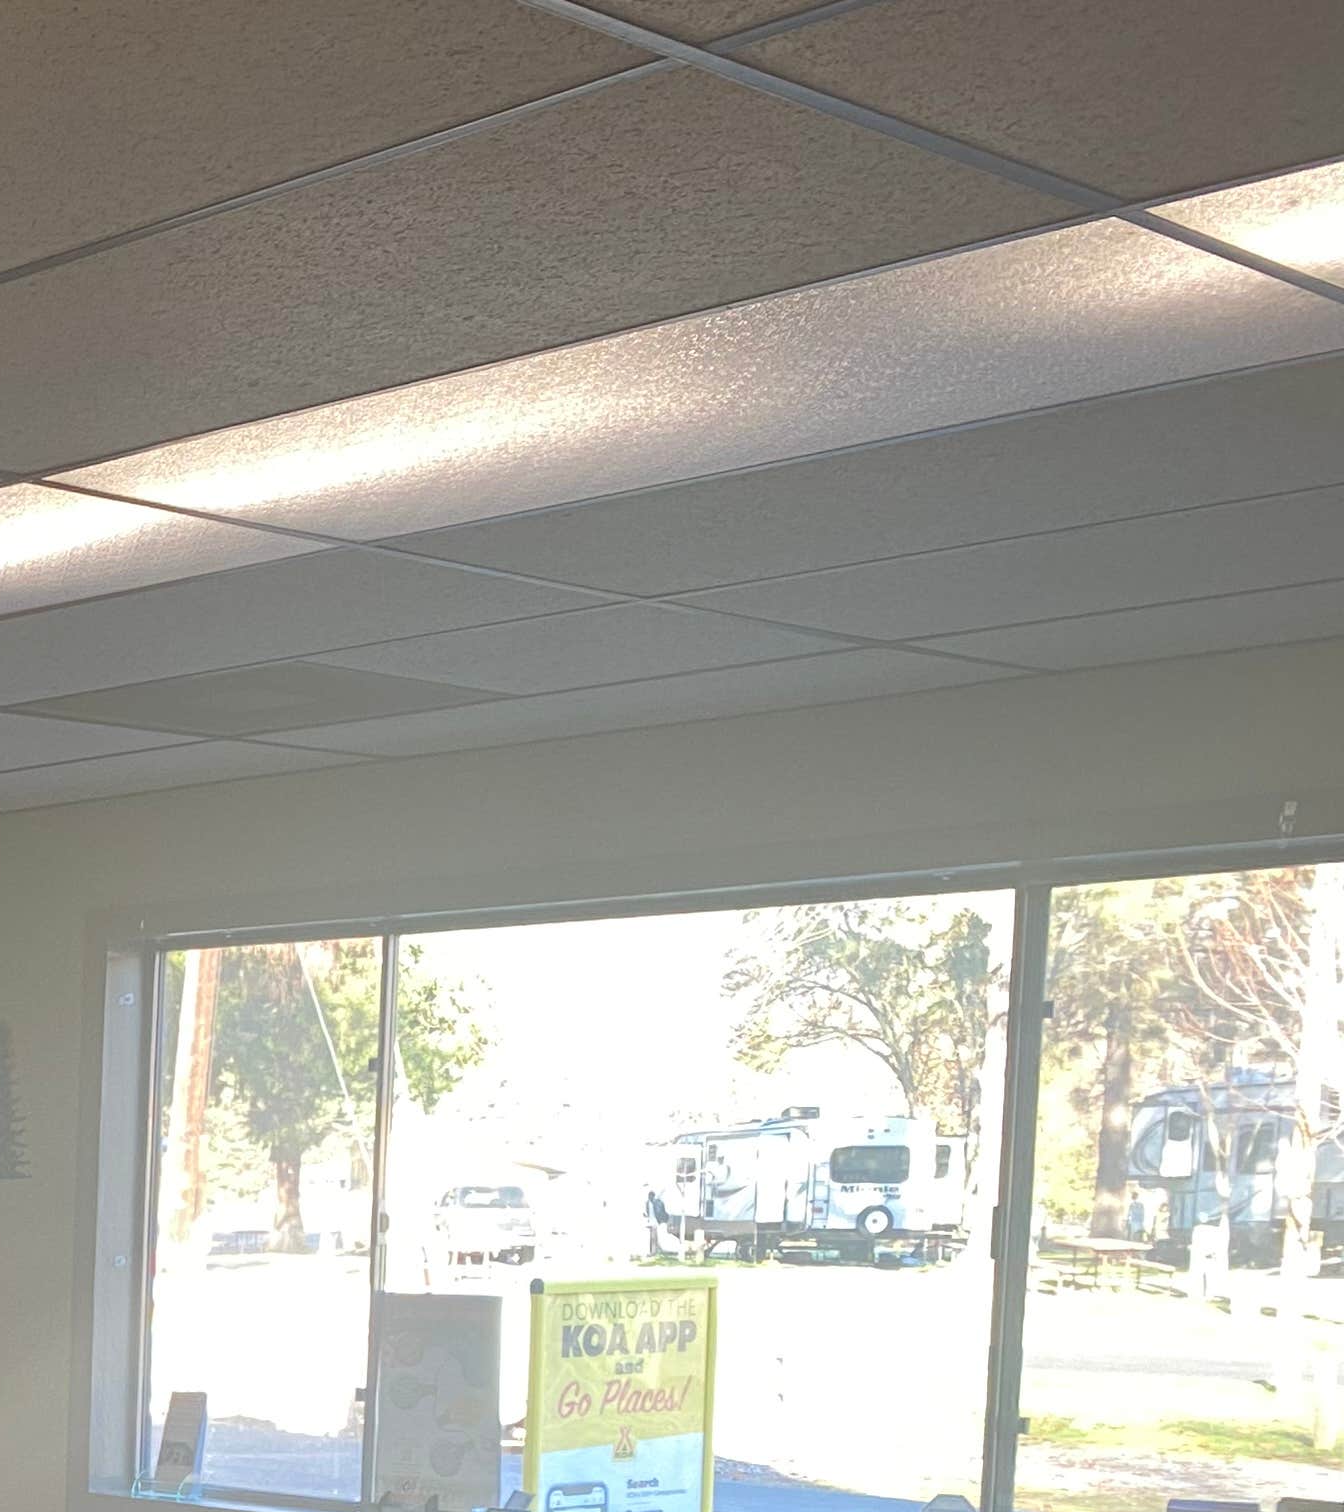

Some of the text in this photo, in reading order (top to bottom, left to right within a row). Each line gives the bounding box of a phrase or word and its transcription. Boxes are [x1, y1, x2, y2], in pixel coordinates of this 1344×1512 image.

[562, 1300, 660, 1321] DOWNLOAD
[561, 1320, 697, 1358] KOA APP
[615, 1358, 644, 1375] and
[557, 1375, 693, 1419] Go Places!
